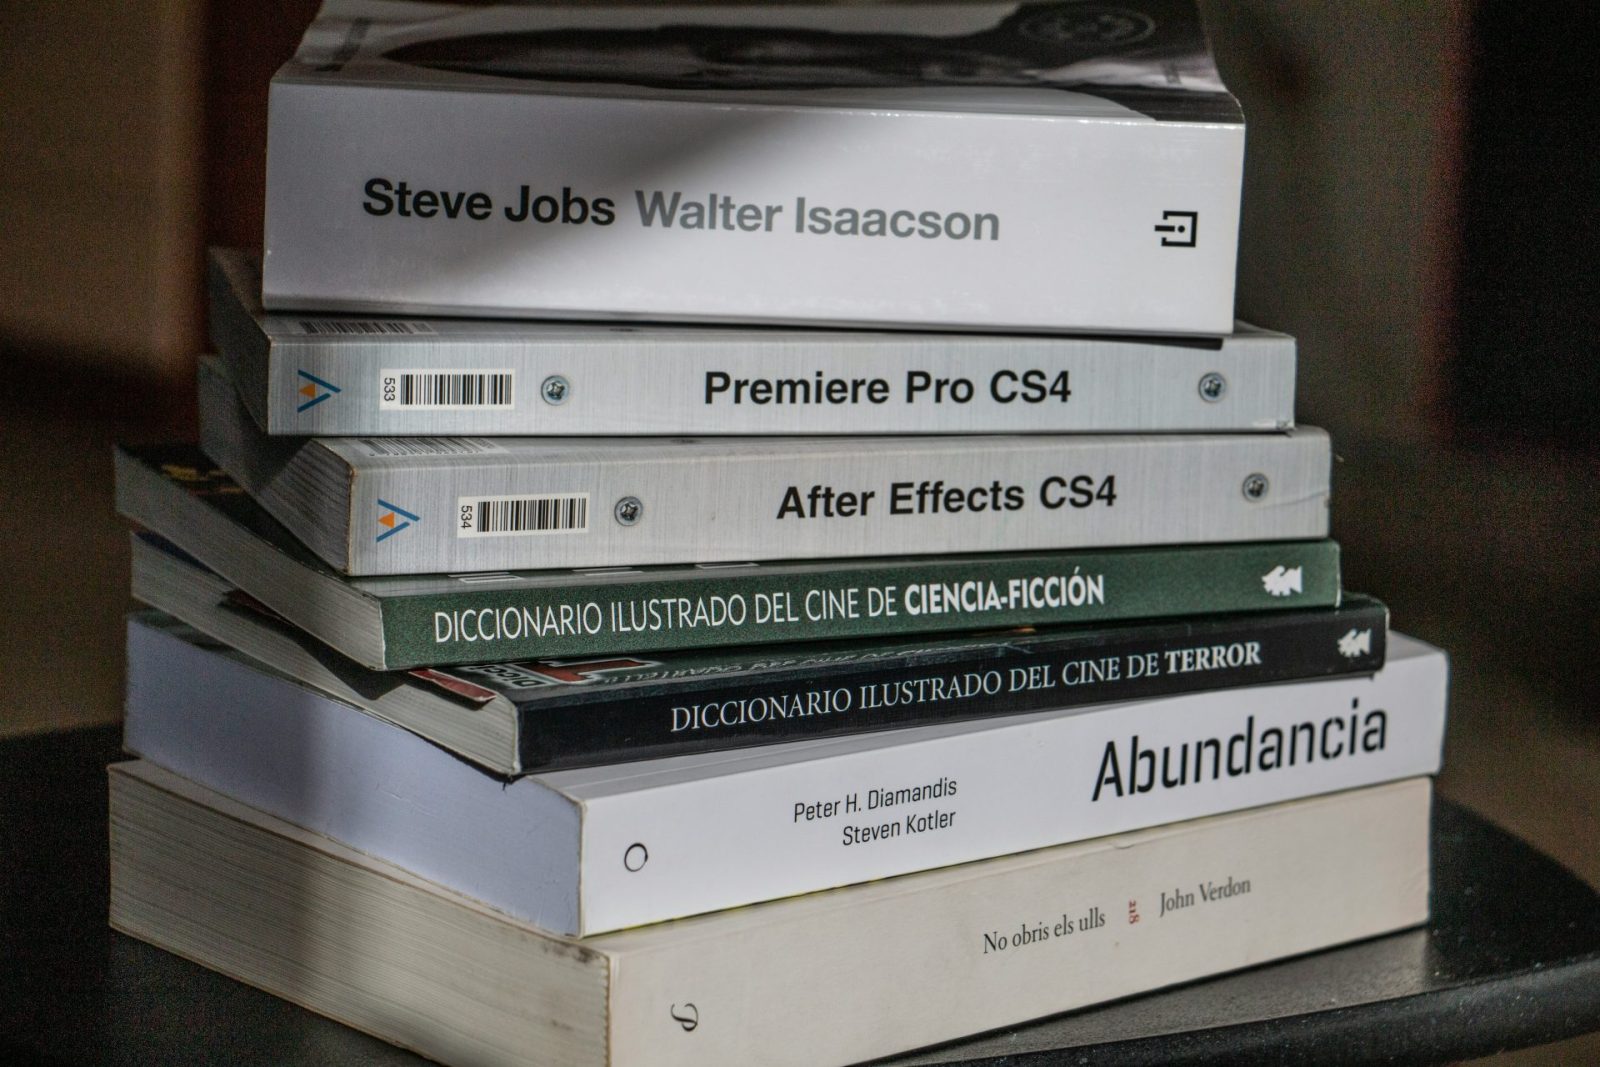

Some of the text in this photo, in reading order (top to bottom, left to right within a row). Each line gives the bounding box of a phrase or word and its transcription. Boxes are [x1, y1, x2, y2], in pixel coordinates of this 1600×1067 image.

[363, 178, 1000, 241] Steve Jobs Walter Isaacson
[384, 376, 396, 403] 533
[705, 369, 1072, 405] Premiere Pro CS4
[460, 503, 473, 530] 534
[776, 474, 1118, 520] After Effects CS4
[434, 565, 1105, 644] DICCIONARIO ILUSTRADO DEL CINE DE CIENCIA-FICCIÓN
[669, 641, 1263, 733] DICCIONARIO ILUSTRADO DEL CINE DE TERROR
[1091, 697, 1388, 803] Abundancia
[794, 777, 957, 824] Peter H. Diamandis
[842, 810, 956, 847] Steven Kotler
[1160, 876, 1252, 917] John Verdon
[983, 906, 1106, 955] No obris els ulls
